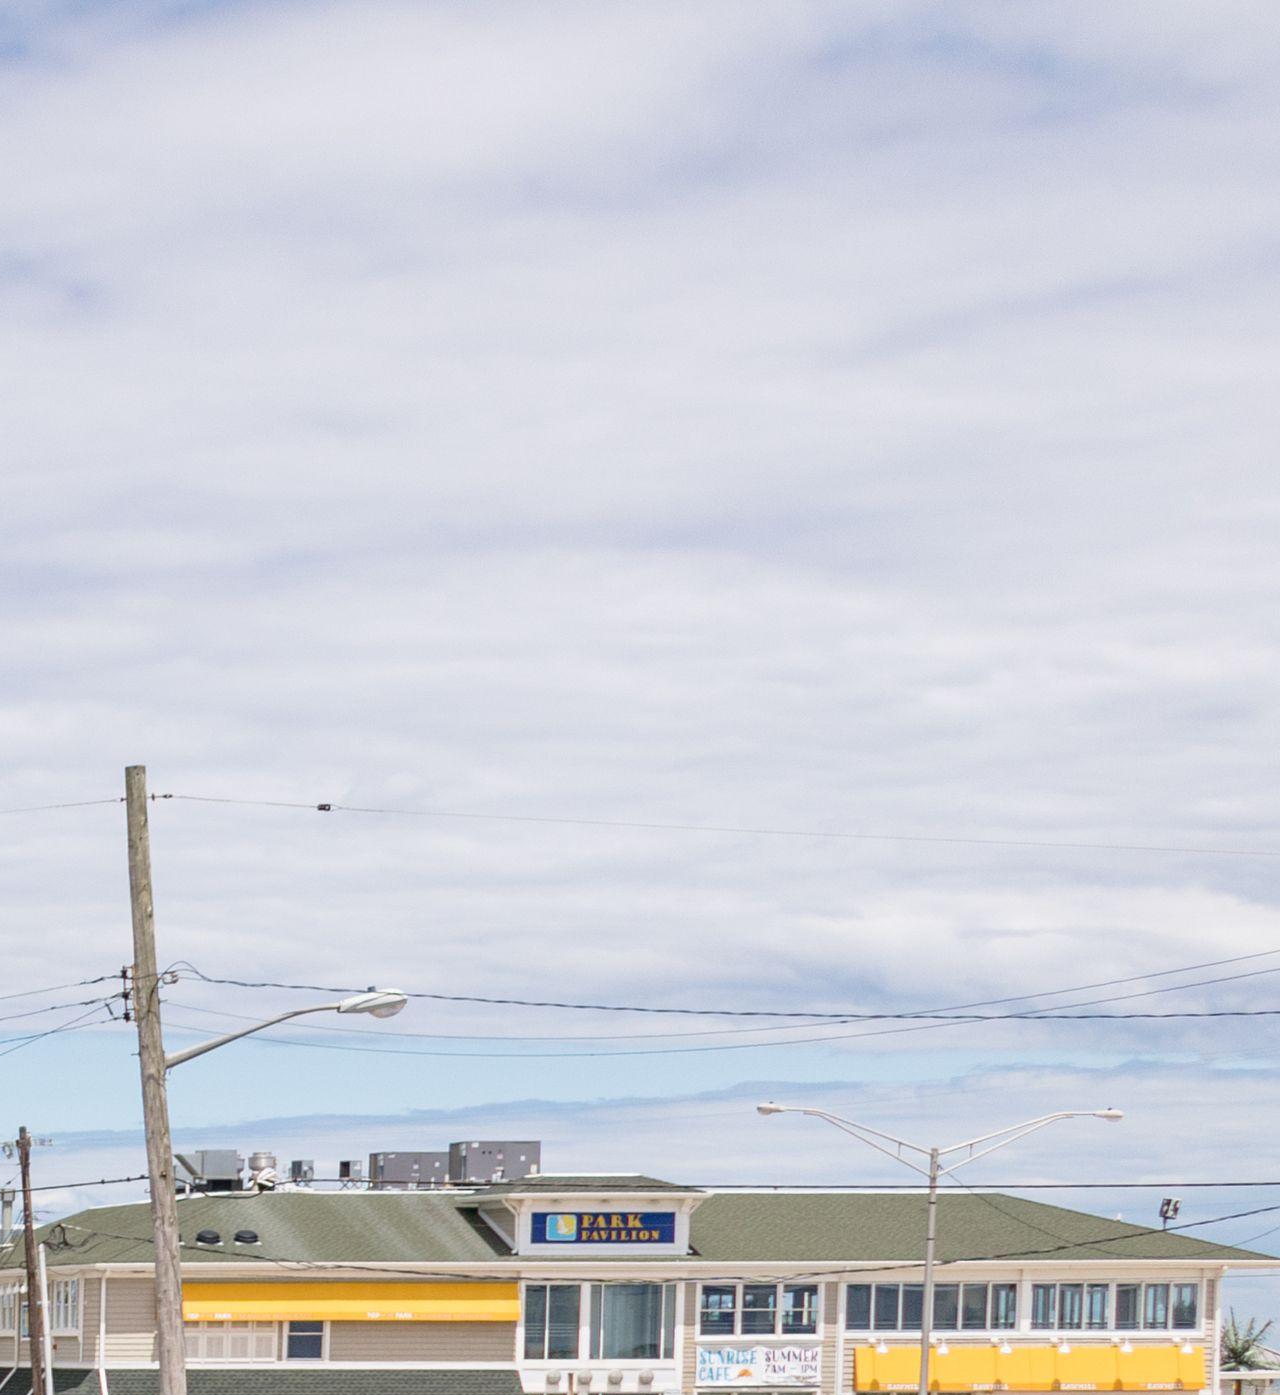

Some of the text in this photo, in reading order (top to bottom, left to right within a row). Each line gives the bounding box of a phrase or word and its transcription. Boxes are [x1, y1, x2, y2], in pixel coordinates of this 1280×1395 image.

[581, 1214, 643, 1228] PARK
[581, 1230, 660, 1241] PAVILION
[765, 1350, 818, 1362] SUMMER
